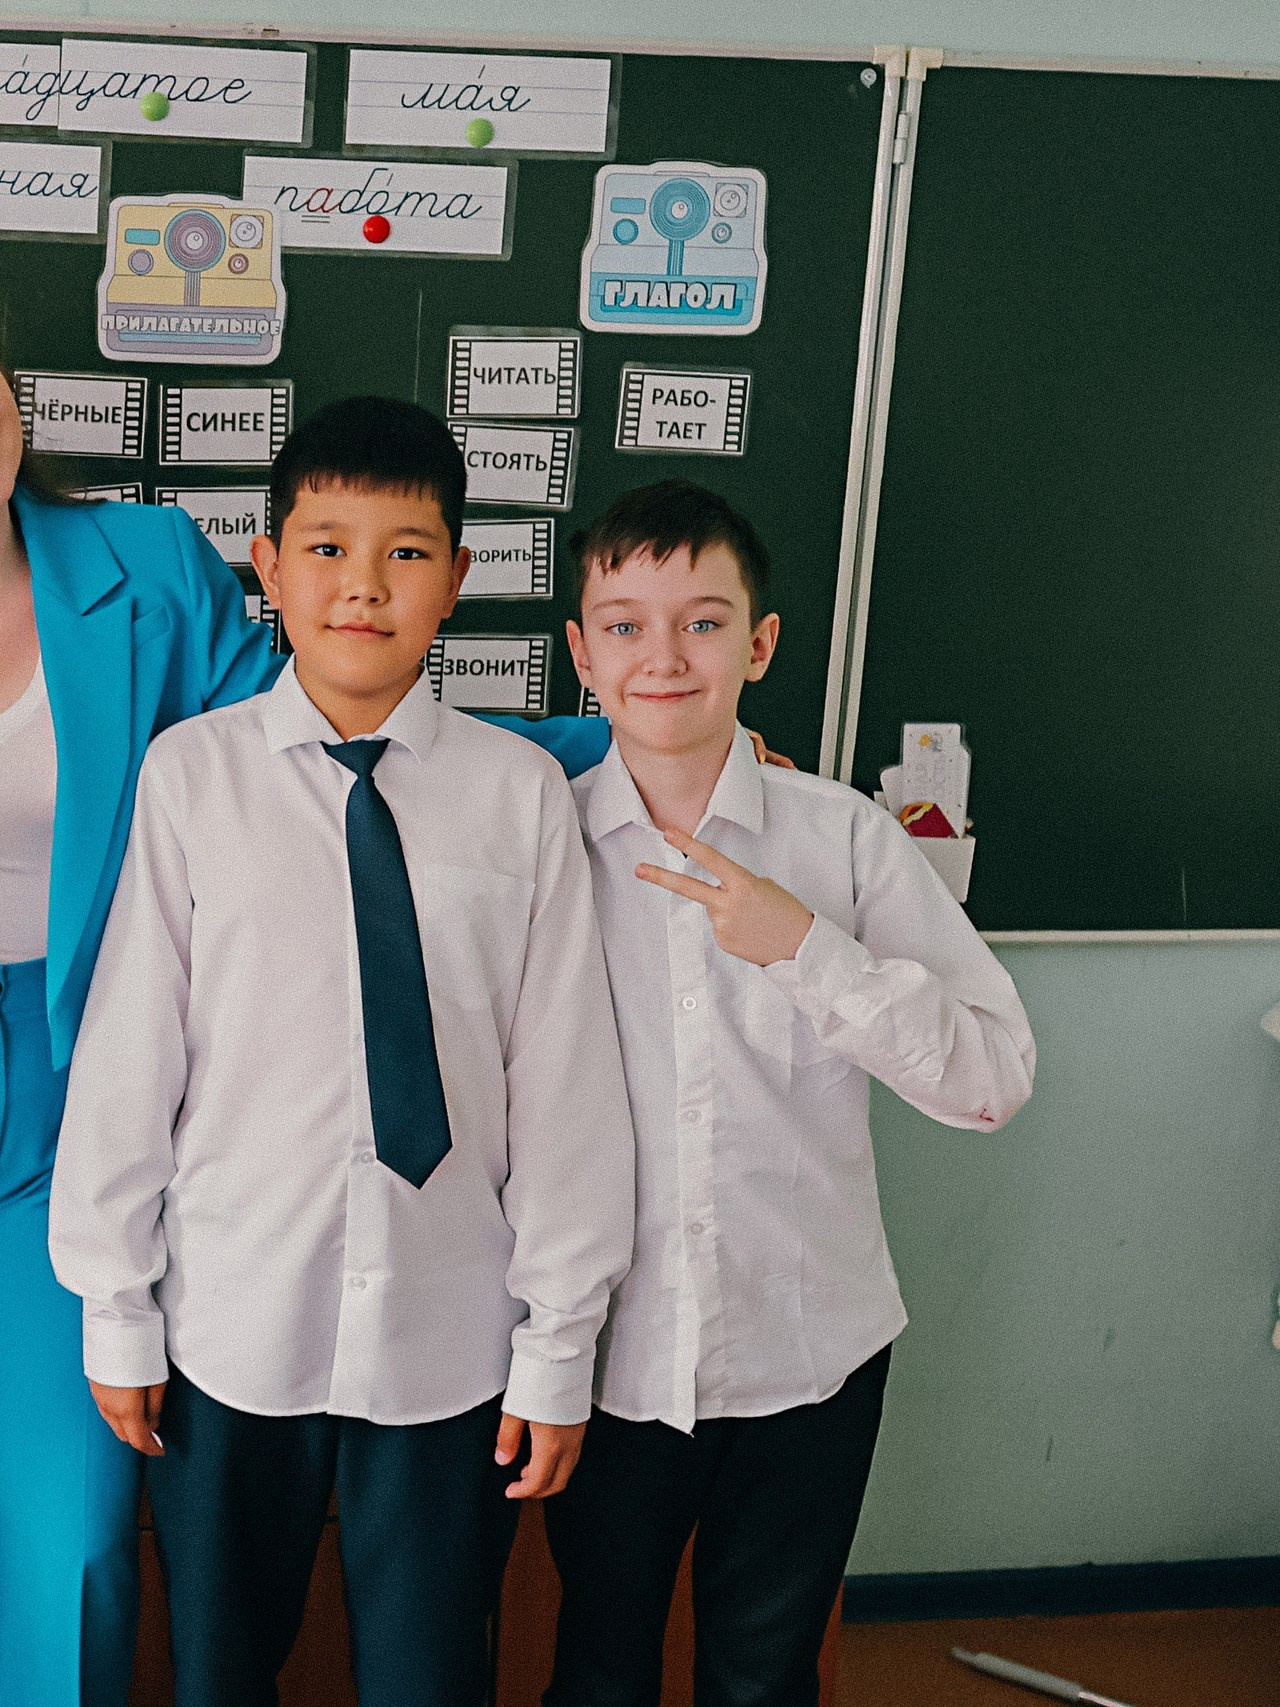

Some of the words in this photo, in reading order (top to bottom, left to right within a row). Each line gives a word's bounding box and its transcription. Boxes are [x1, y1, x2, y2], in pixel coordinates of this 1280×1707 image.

[603, 280, 738, 310] ГЛАГОЛ
[100, 314, 282, 336] ПРИЛАГАТЕЛЬНОЕ
[472, 366, 557, 386] ЧИТАТЬ
[650, 387, 717, 408] РАБО-
[32, 398, 123, 424] ЧЁРНЫЕ
[185, 411, 266, 433] СИНЕЕ
[655, 420, 708, 441] ТАЕТ
[466, 450, 549, 472] СТОЯТЬ
[469, 548, 532, 563] ВОРИТЬ
[442, 658, 529, 677] ЗВОНИТ
